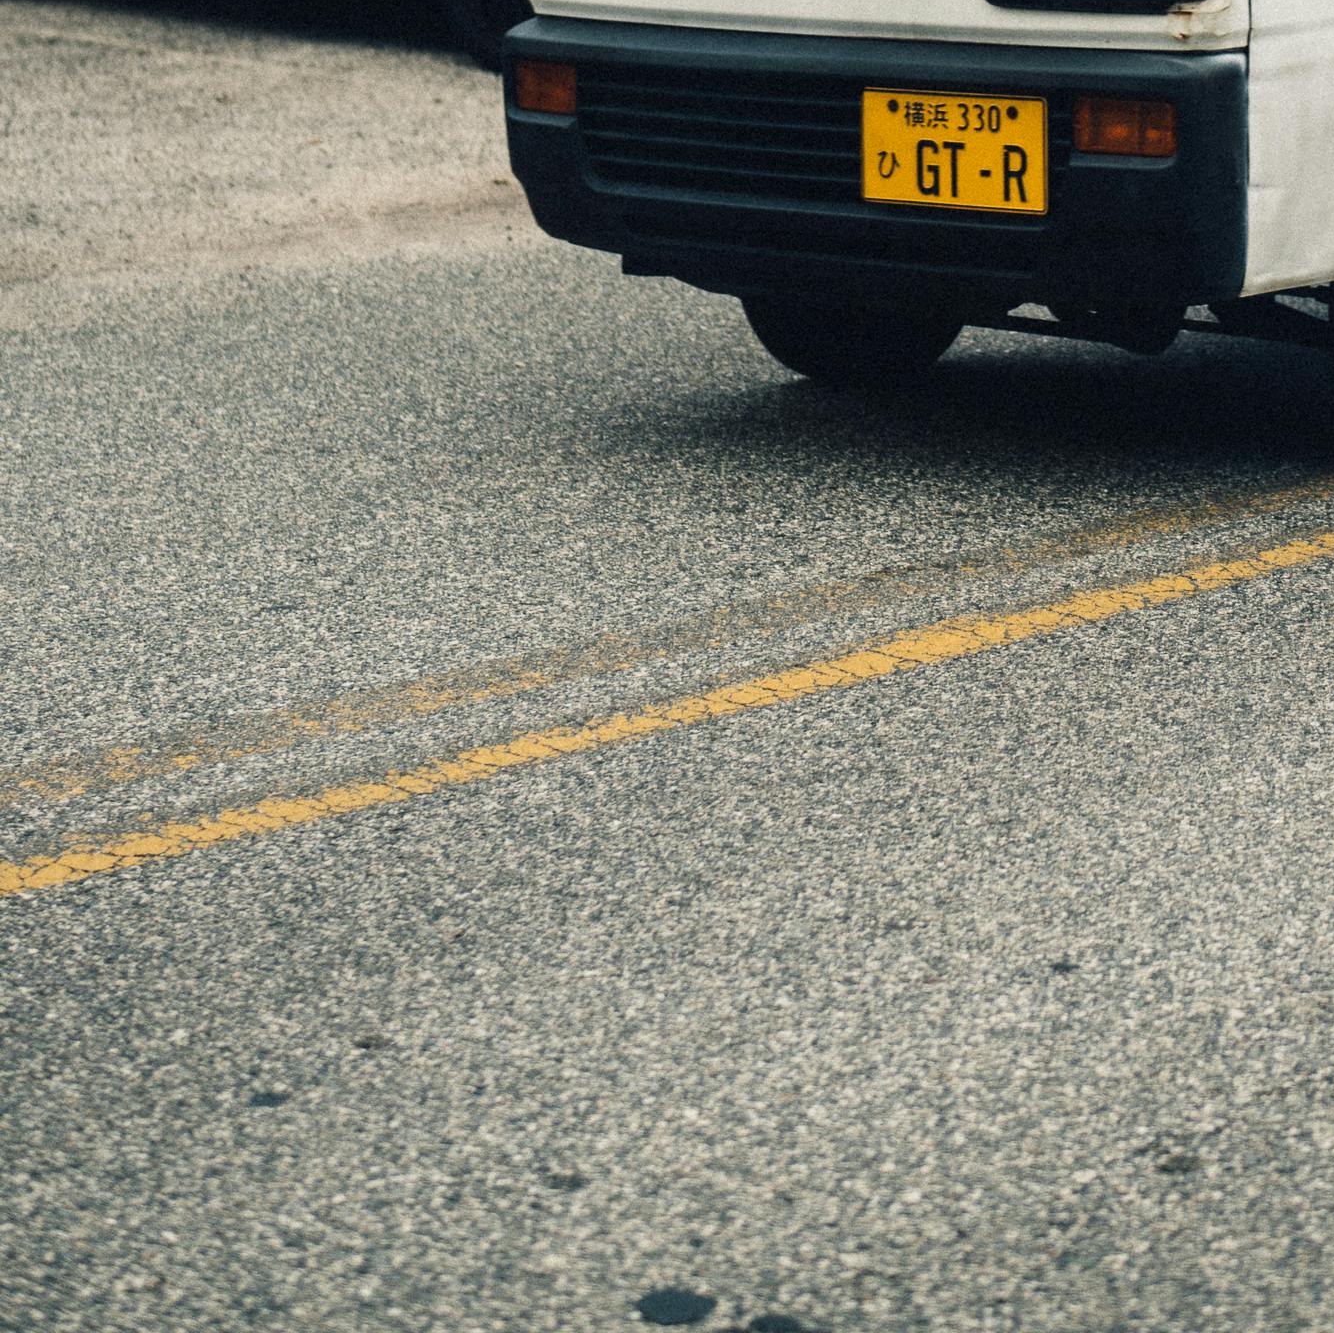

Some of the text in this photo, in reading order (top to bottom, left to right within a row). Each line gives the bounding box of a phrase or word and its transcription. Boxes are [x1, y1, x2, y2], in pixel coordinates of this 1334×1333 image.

[904, 101, 1001, 133] 横浜 330
[877, 150, 900, 179] ひ
